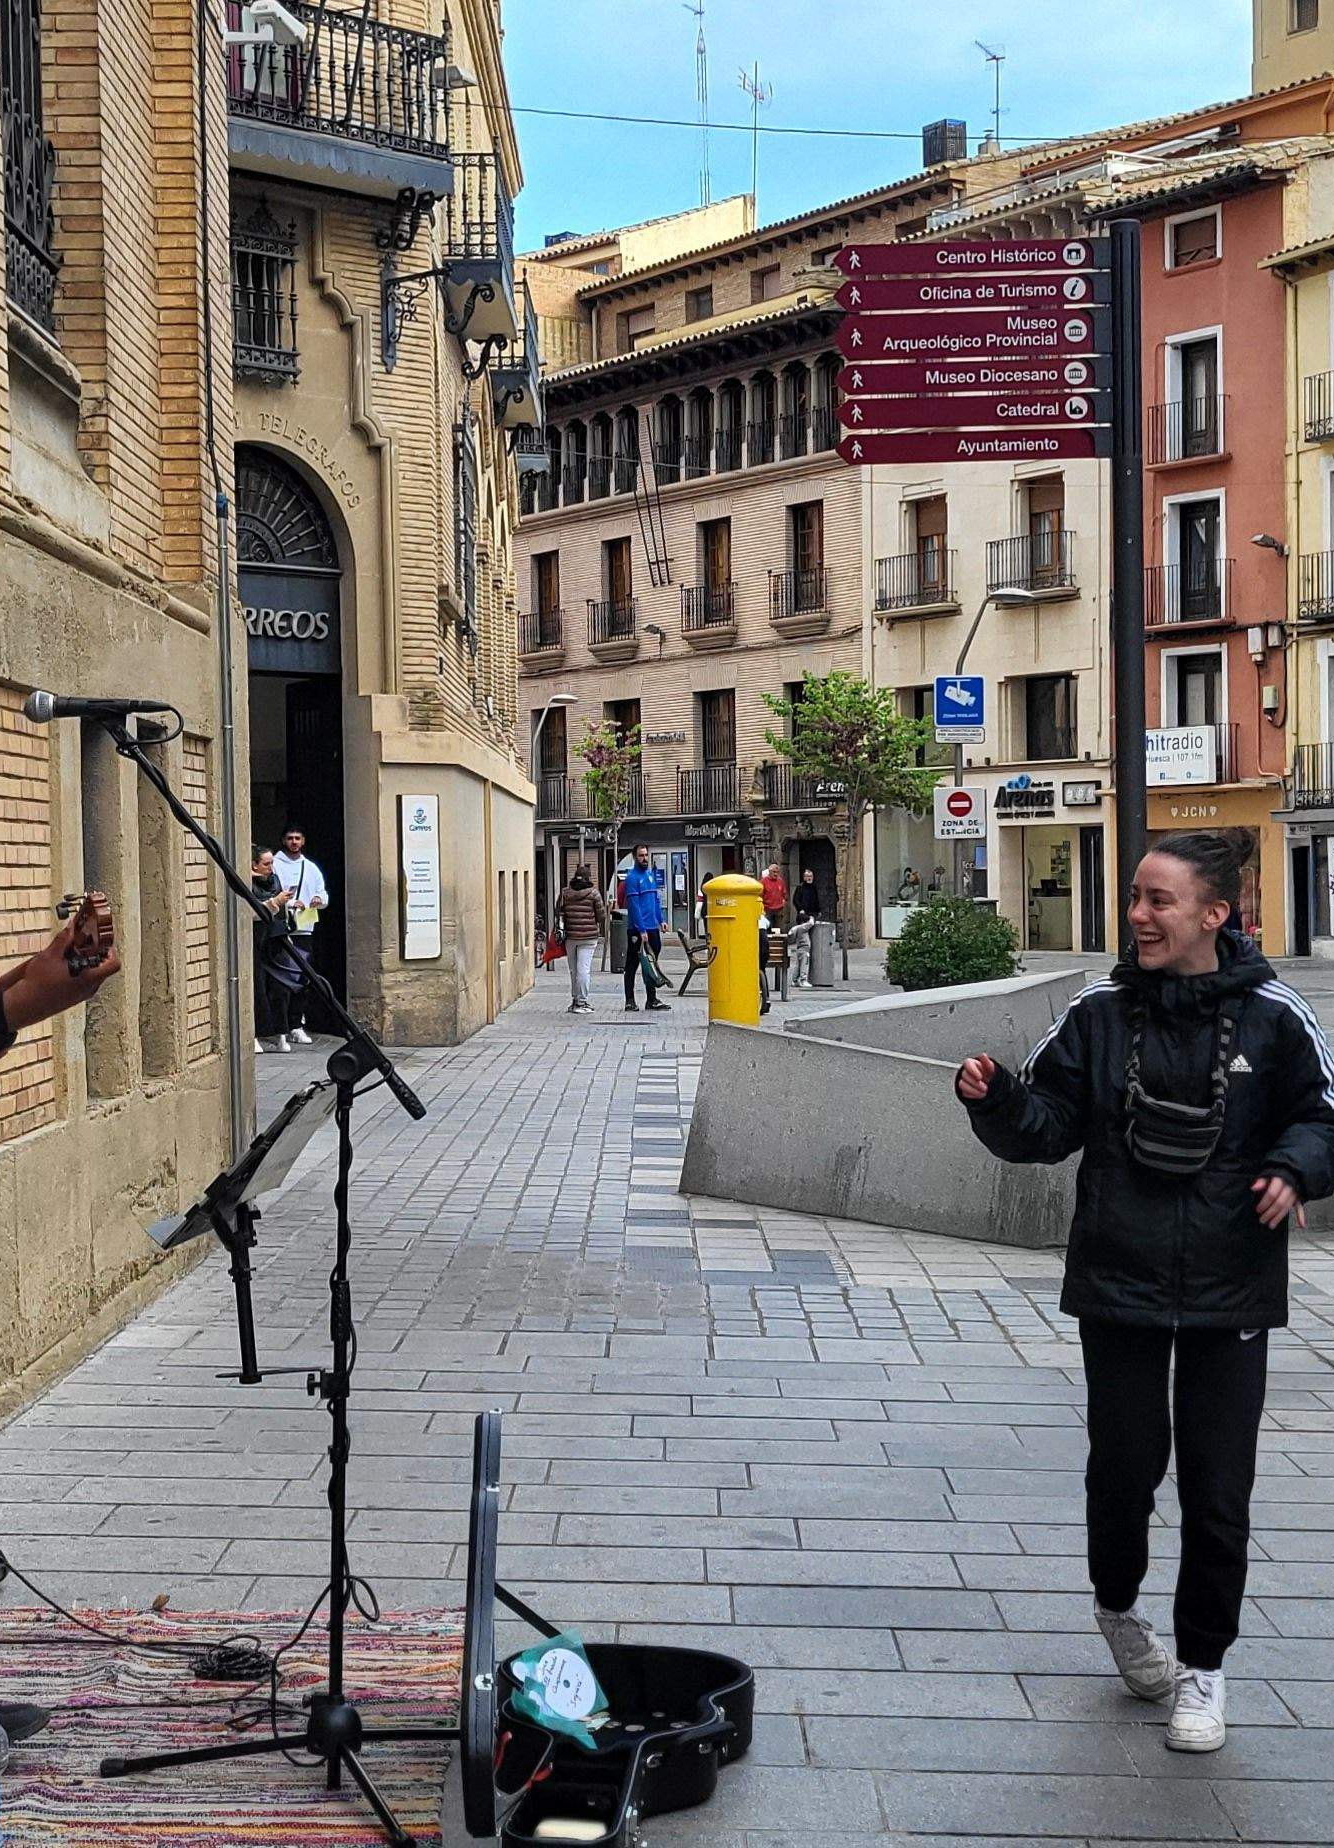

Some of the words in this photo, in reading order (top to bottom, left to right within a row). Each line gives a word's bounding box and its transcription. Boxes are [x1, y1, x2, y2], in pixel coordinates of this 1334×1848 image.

[936, 250, 987, 265] Centro
[990, 248, 1057, 264] Histórico
[919, 286, 972, 301] Oficina
[975, 285, 995, 299] de
[998, 283, 1057, 298] Turismo
[1006, 316, 1058, 330] Museo
[882, 334, 982, 352] Arqueológico
[985, 332, 1058, 348] Provincial
[925, 370, 976, 384] Museo
[979, 368, 1058, 383] Diocesano
[996, 401, 1059, 417] Catedral
[956, 437, 1059, 456] Ayuntamiento
[258, 413, 360, 508] TELEGRAFOS
[1145, 732, 1204, 752] hitradio
[993, 786, 1055, 808] Arenas
